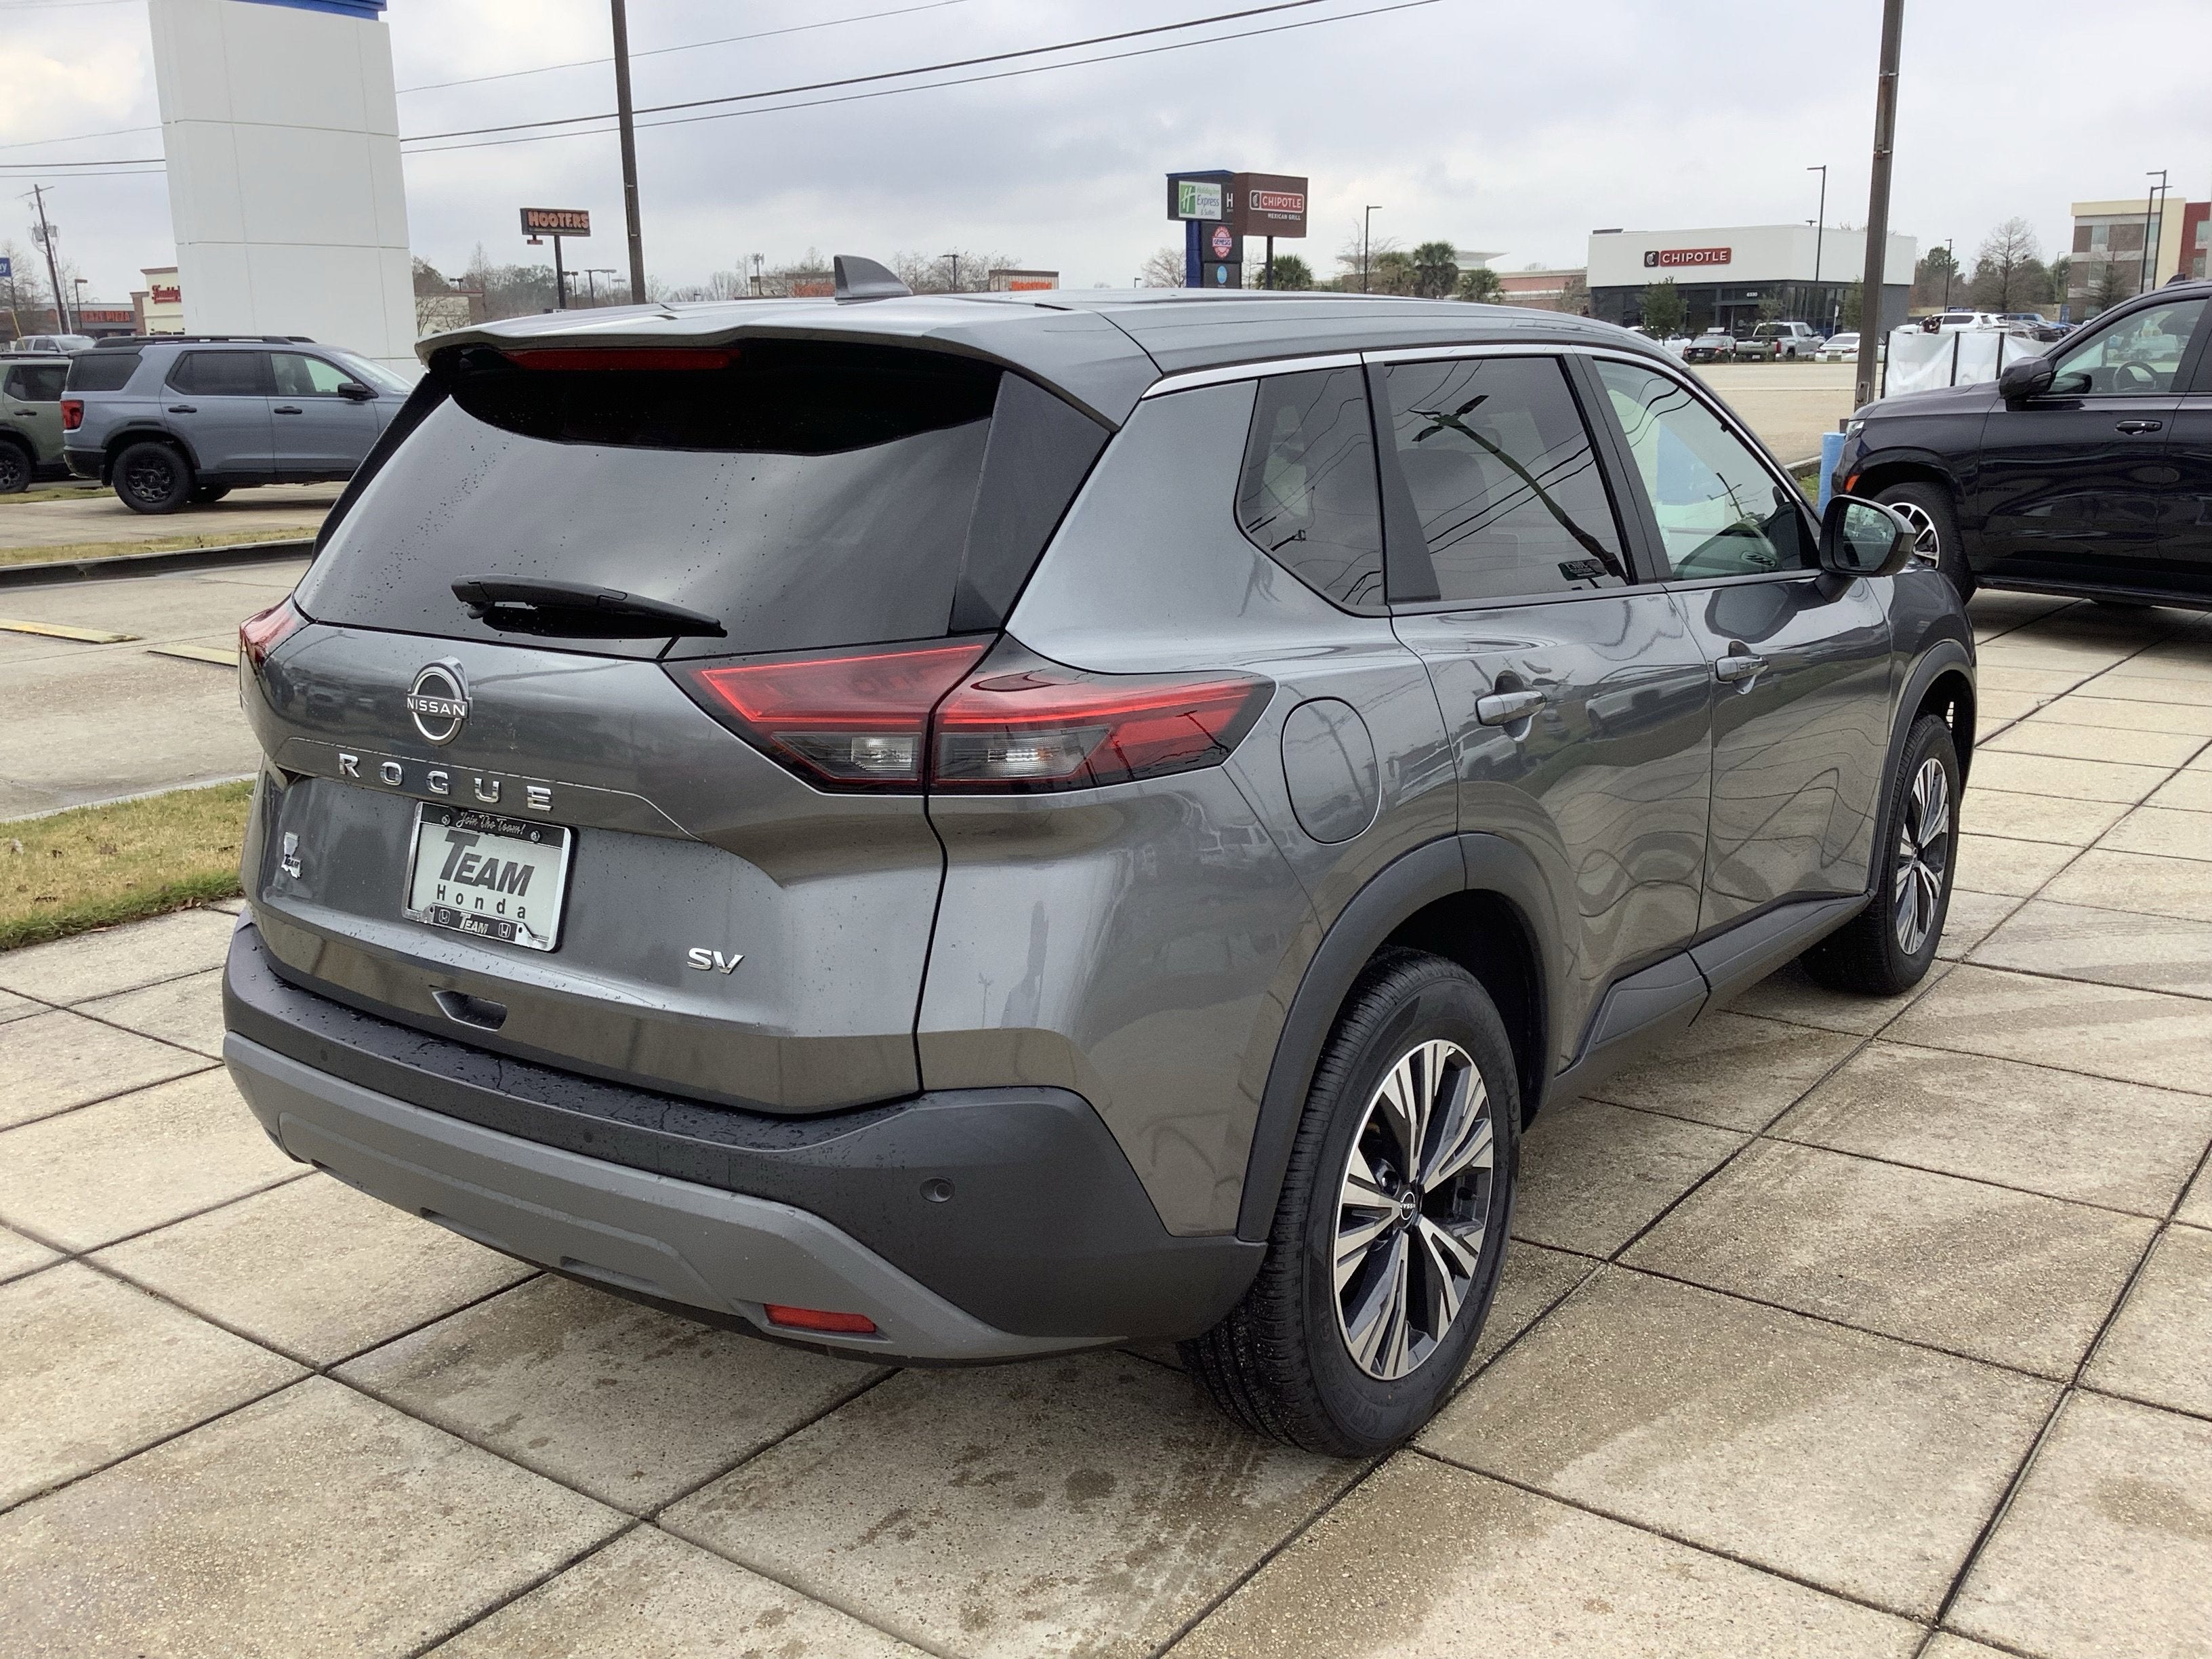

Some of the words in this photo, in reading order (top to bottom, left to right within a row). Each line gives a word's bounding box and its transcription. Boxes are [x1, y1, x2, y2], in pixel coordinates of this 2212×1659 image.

[1197, 194, 1220, 207] Express
[1262, 195, 1302, 209] CHIPOTLE
[528, 211, 589, 228] HOOTERS
[1662, 251, 1727, 264] CHIPOTLE
[407, 697, 466, 717] NISSAN
[339, 752, 553, 811] ROGUE
[455, 812, 478, 827] Join
[479, 815, 495, 830] The
[440, 829, 535, 897] TEAM
[436, 884, 527, 920] Honda
[459, 912, 489, 935] TEAM
[687, 947, 745, 975] SV
